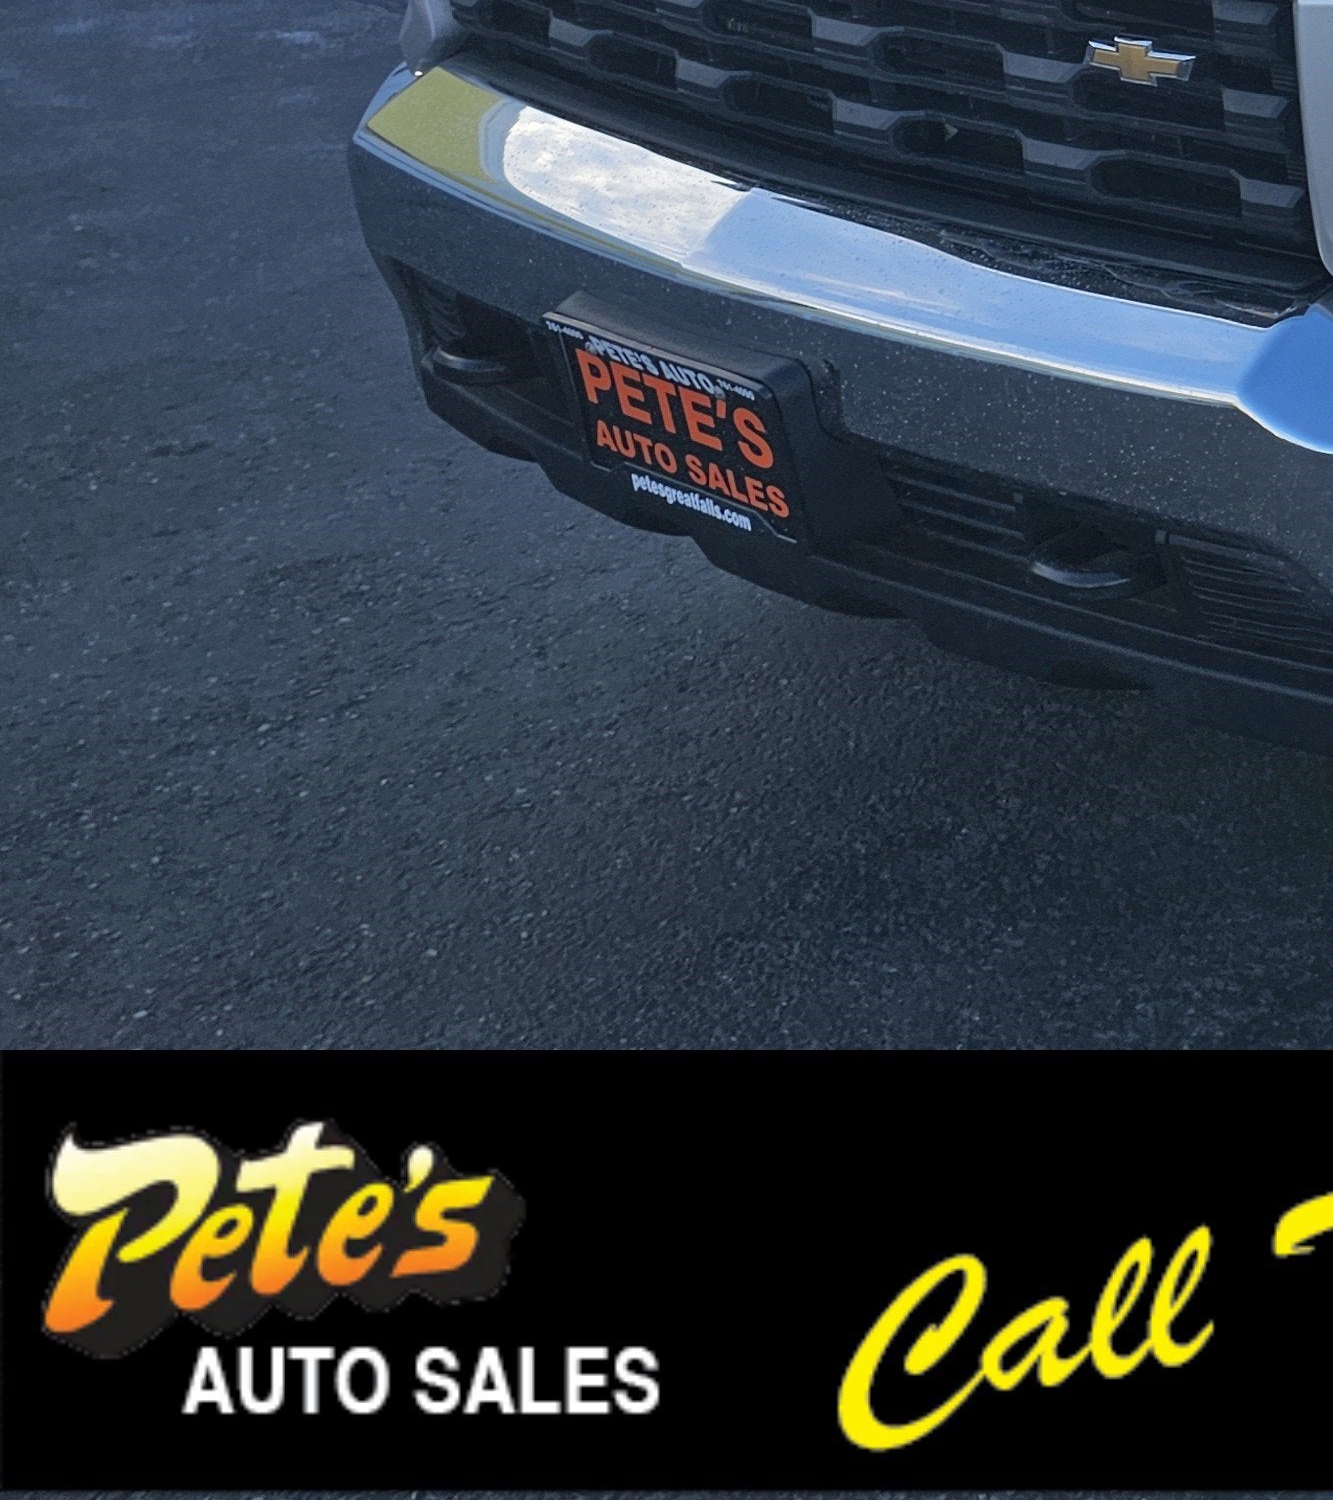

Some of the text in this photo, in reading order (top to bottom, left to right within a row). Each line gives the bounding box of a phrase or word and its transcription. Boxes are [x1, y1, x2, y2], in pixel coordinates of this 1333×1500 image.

[588, 334, 715, 395] PETE'S AUTO
[575, 348, 774, 469] PETE'S
[596, 419, 790, 518] AUTO SALES
[631, 473, 752, 532] petesgreatfalls.com
